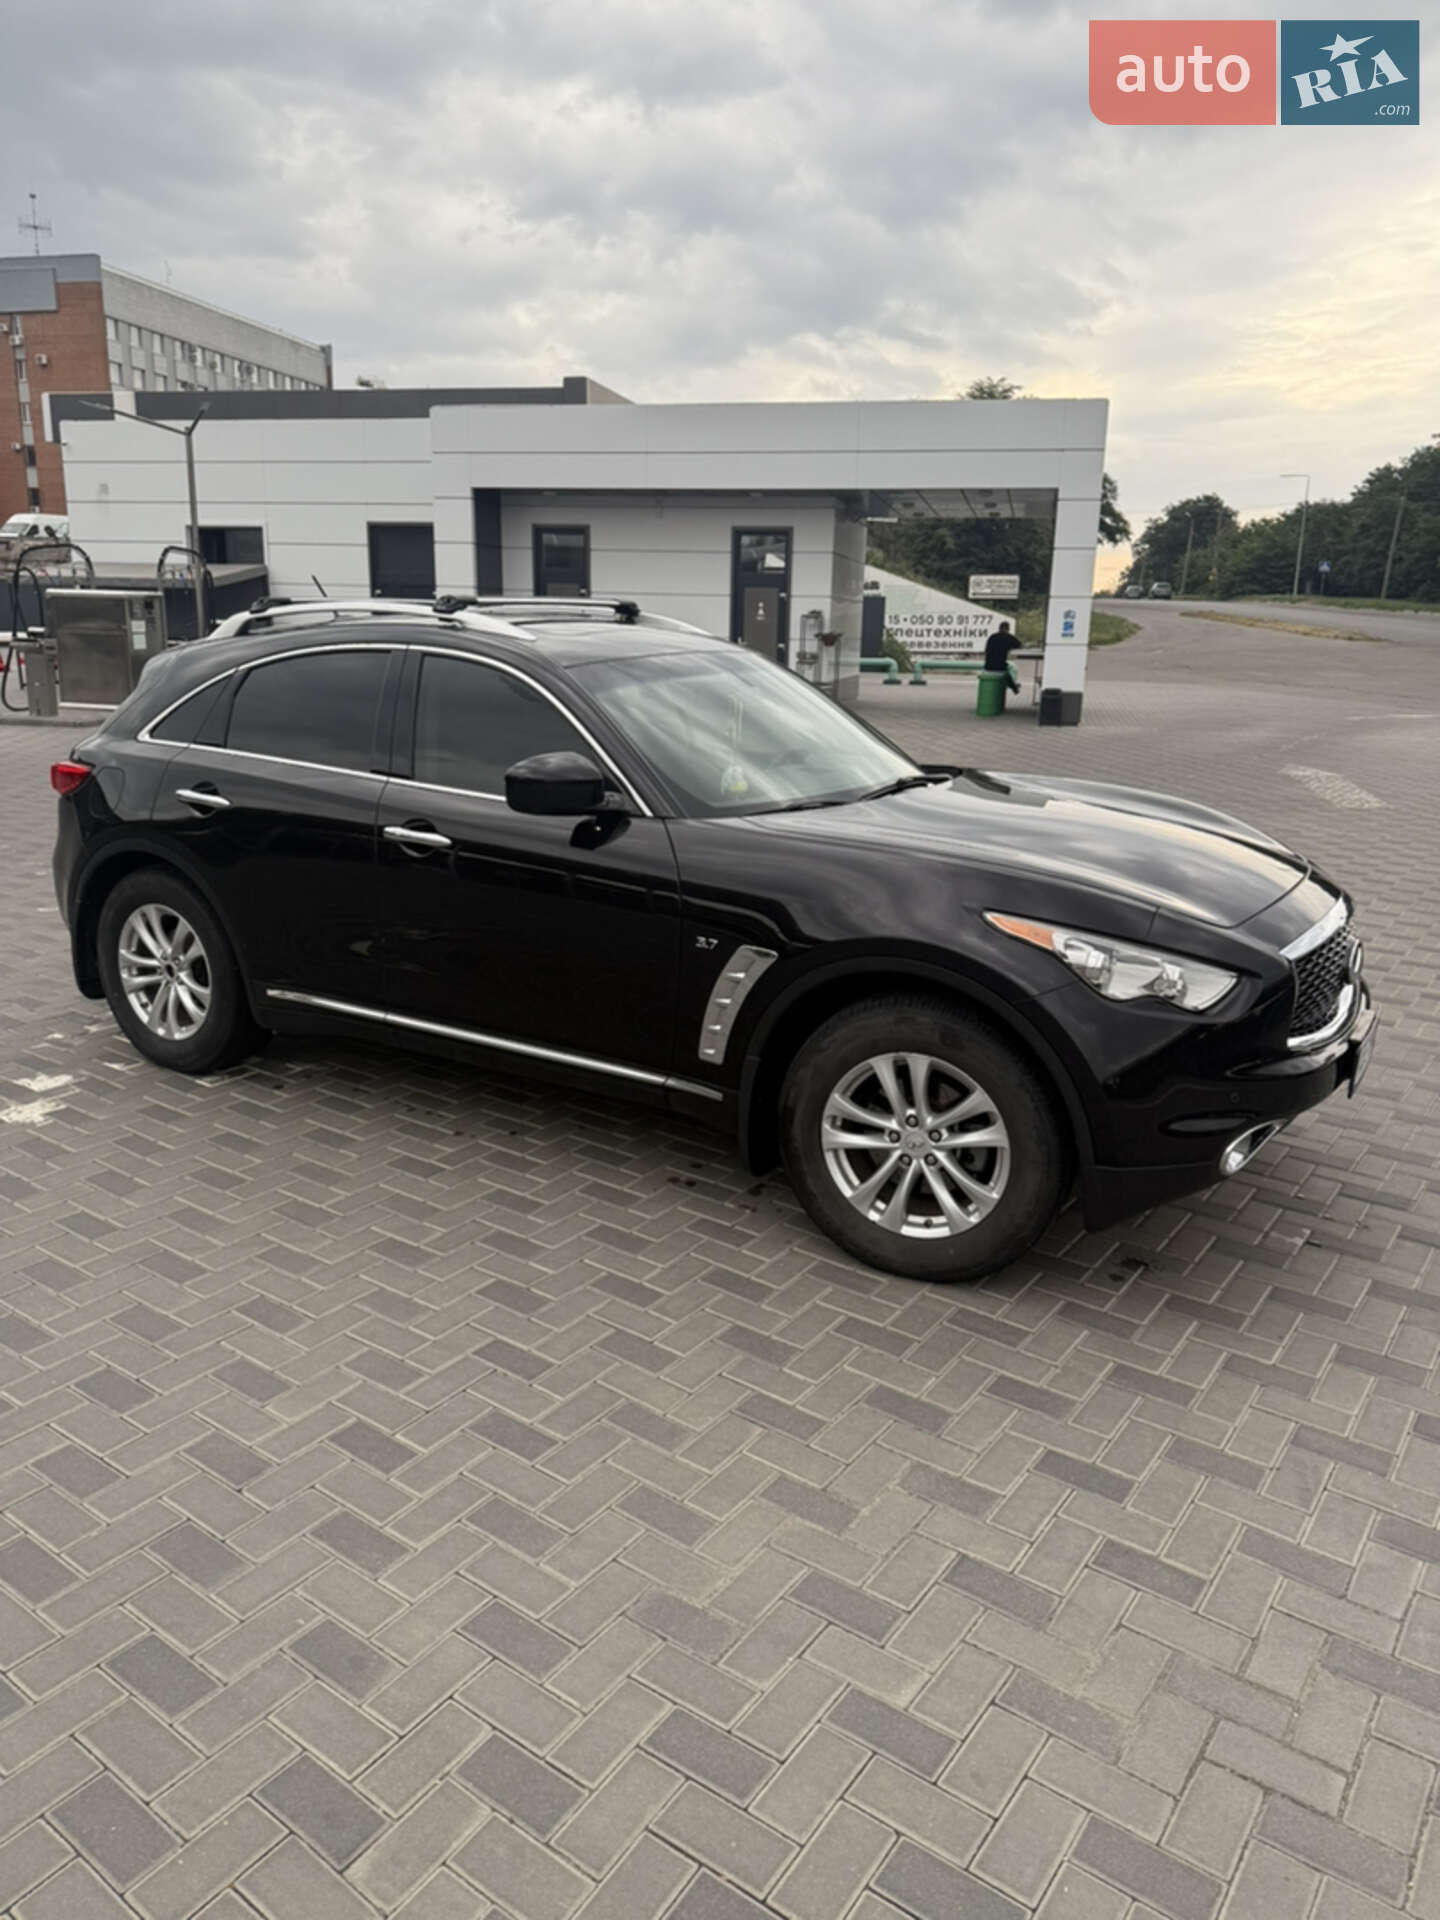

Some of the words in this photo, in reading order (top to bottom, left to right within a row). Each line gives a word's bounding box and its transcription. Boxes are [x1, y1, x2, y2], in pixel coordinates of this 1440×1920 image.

[909, 614, 934, 625] 050
[937, 614, 954, 625] 90
[973, 614, 994, 625] 777
